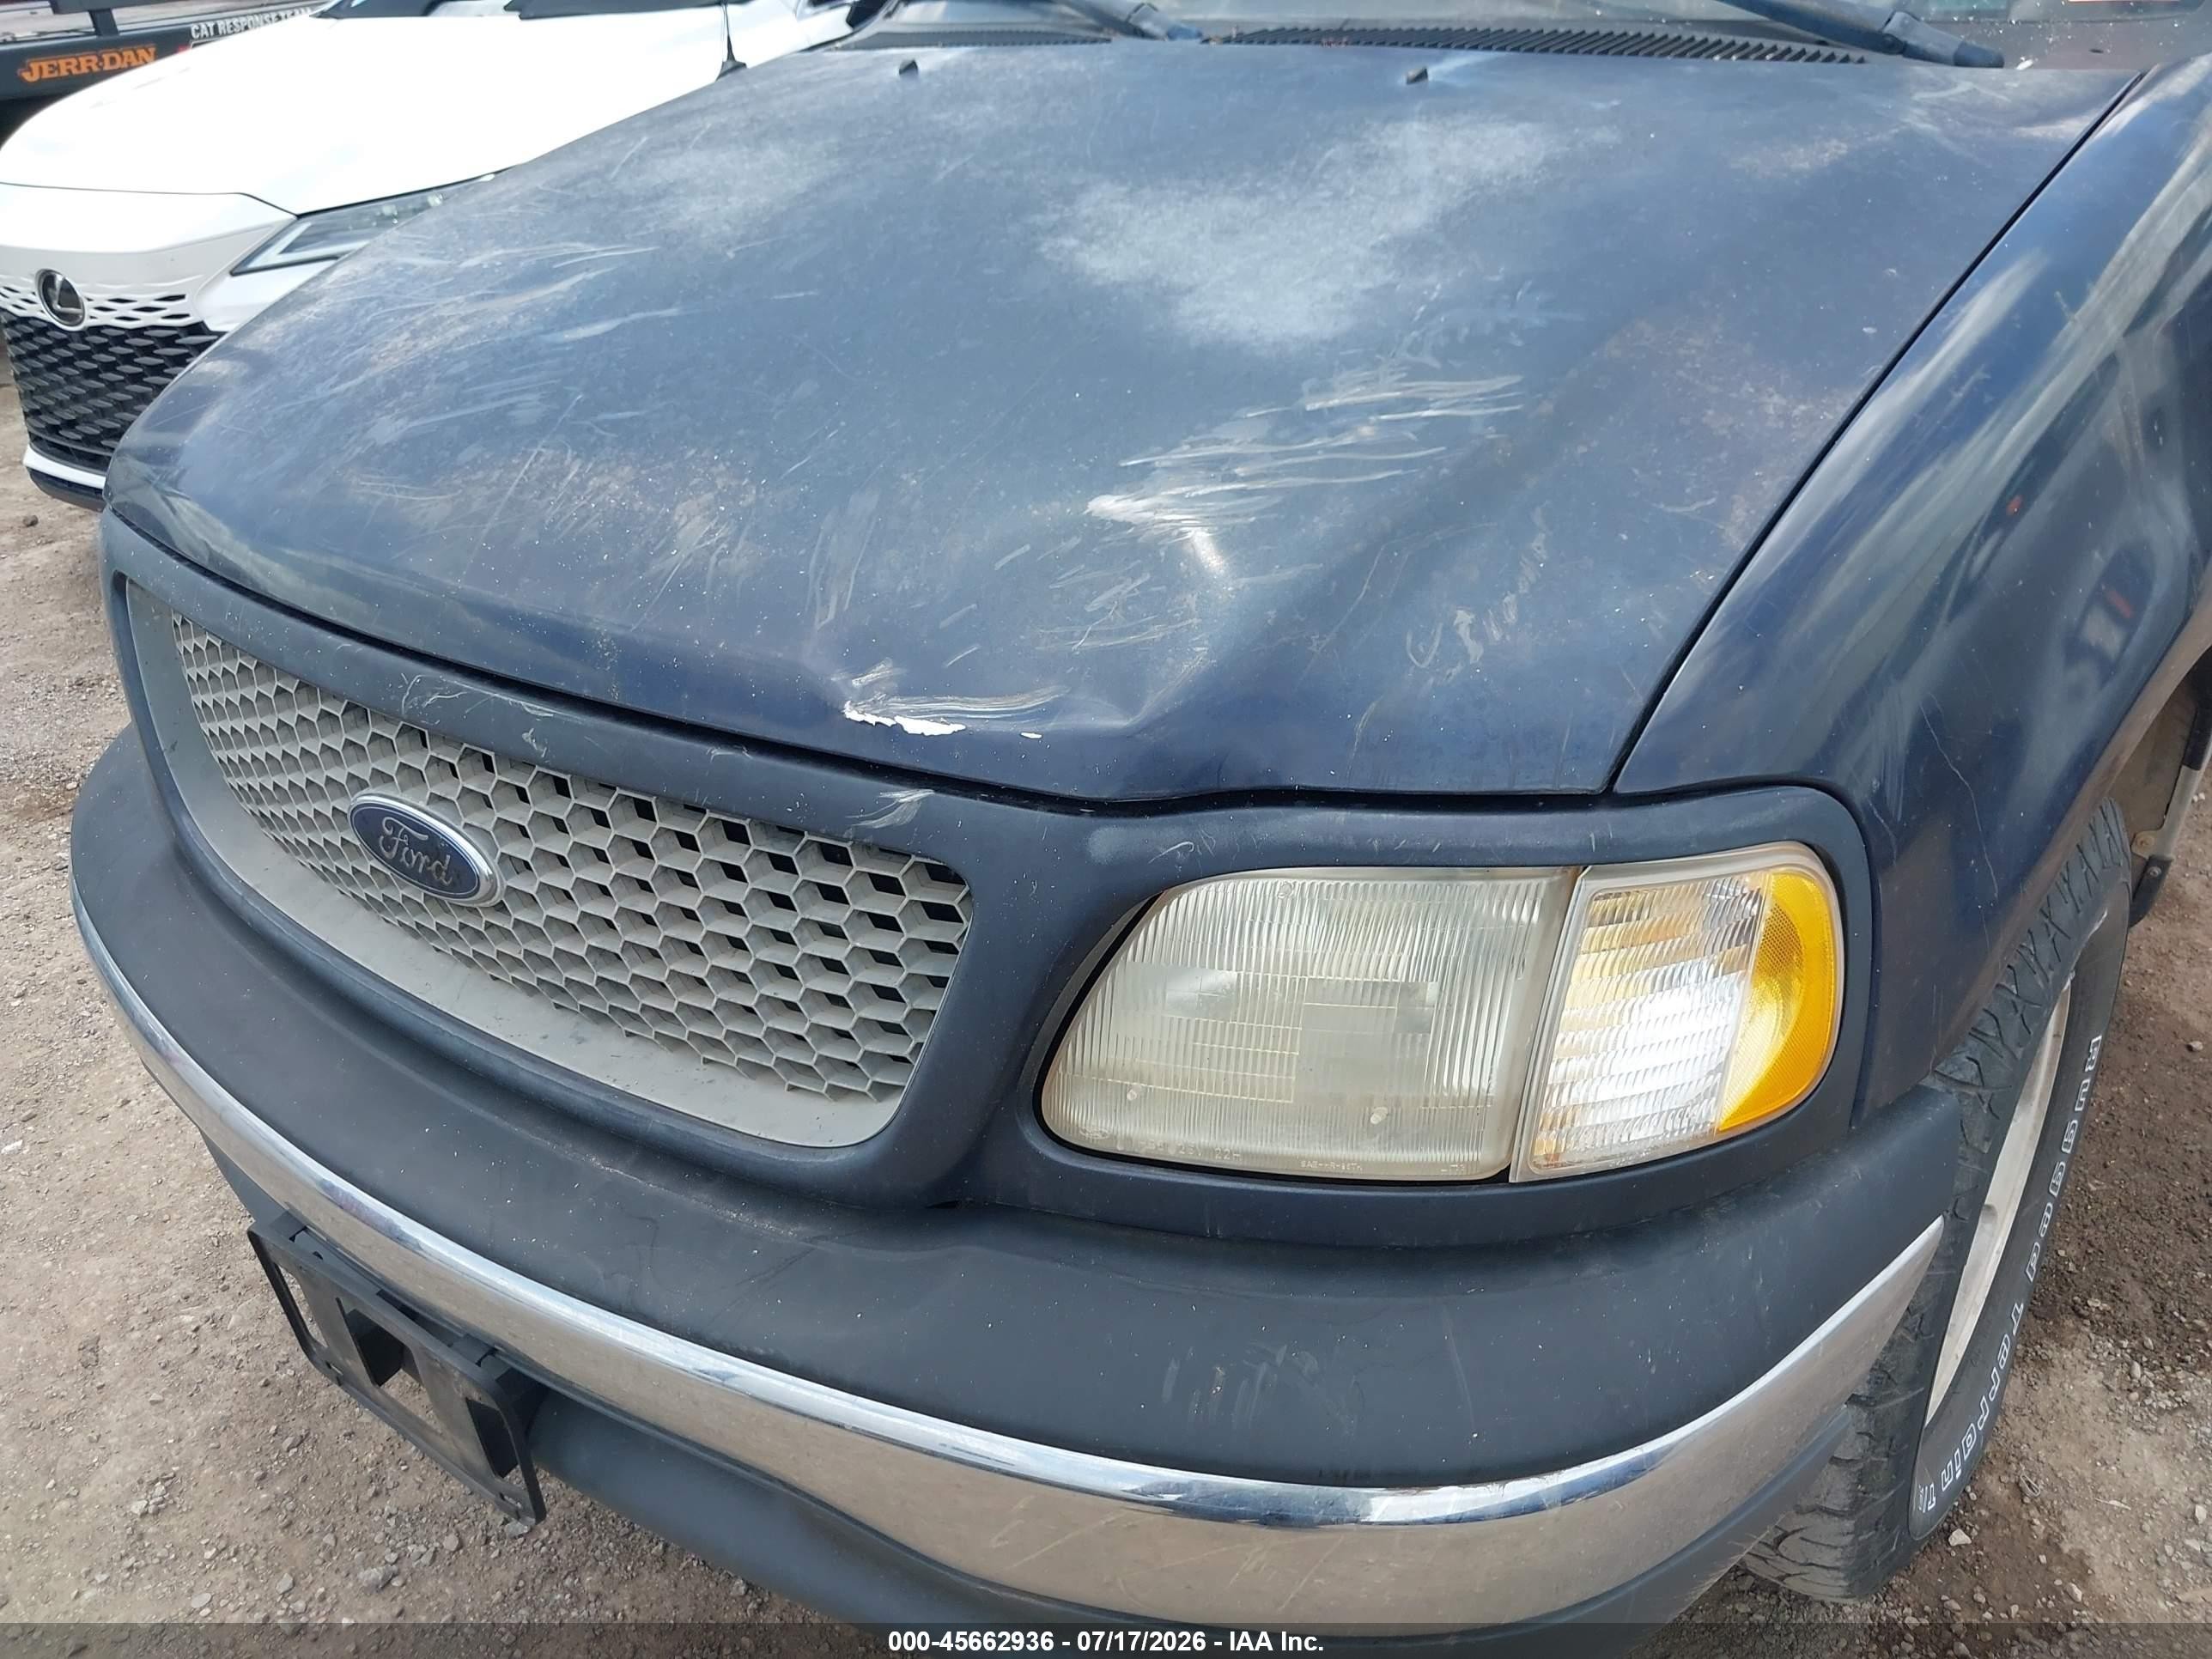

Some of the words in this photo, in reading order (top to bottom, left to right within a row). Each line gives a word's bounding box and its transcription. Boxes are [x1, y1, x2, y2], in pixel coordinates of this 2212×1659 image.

[191, 21, 215, 40] CAT
[216, 13, 282, 35] RESPONSE
[379, 817, 453, 885] Ford
[2026, 1035, 2103, 1283] Rugged
[1941, 1302, 2025, 1492] Terrain
